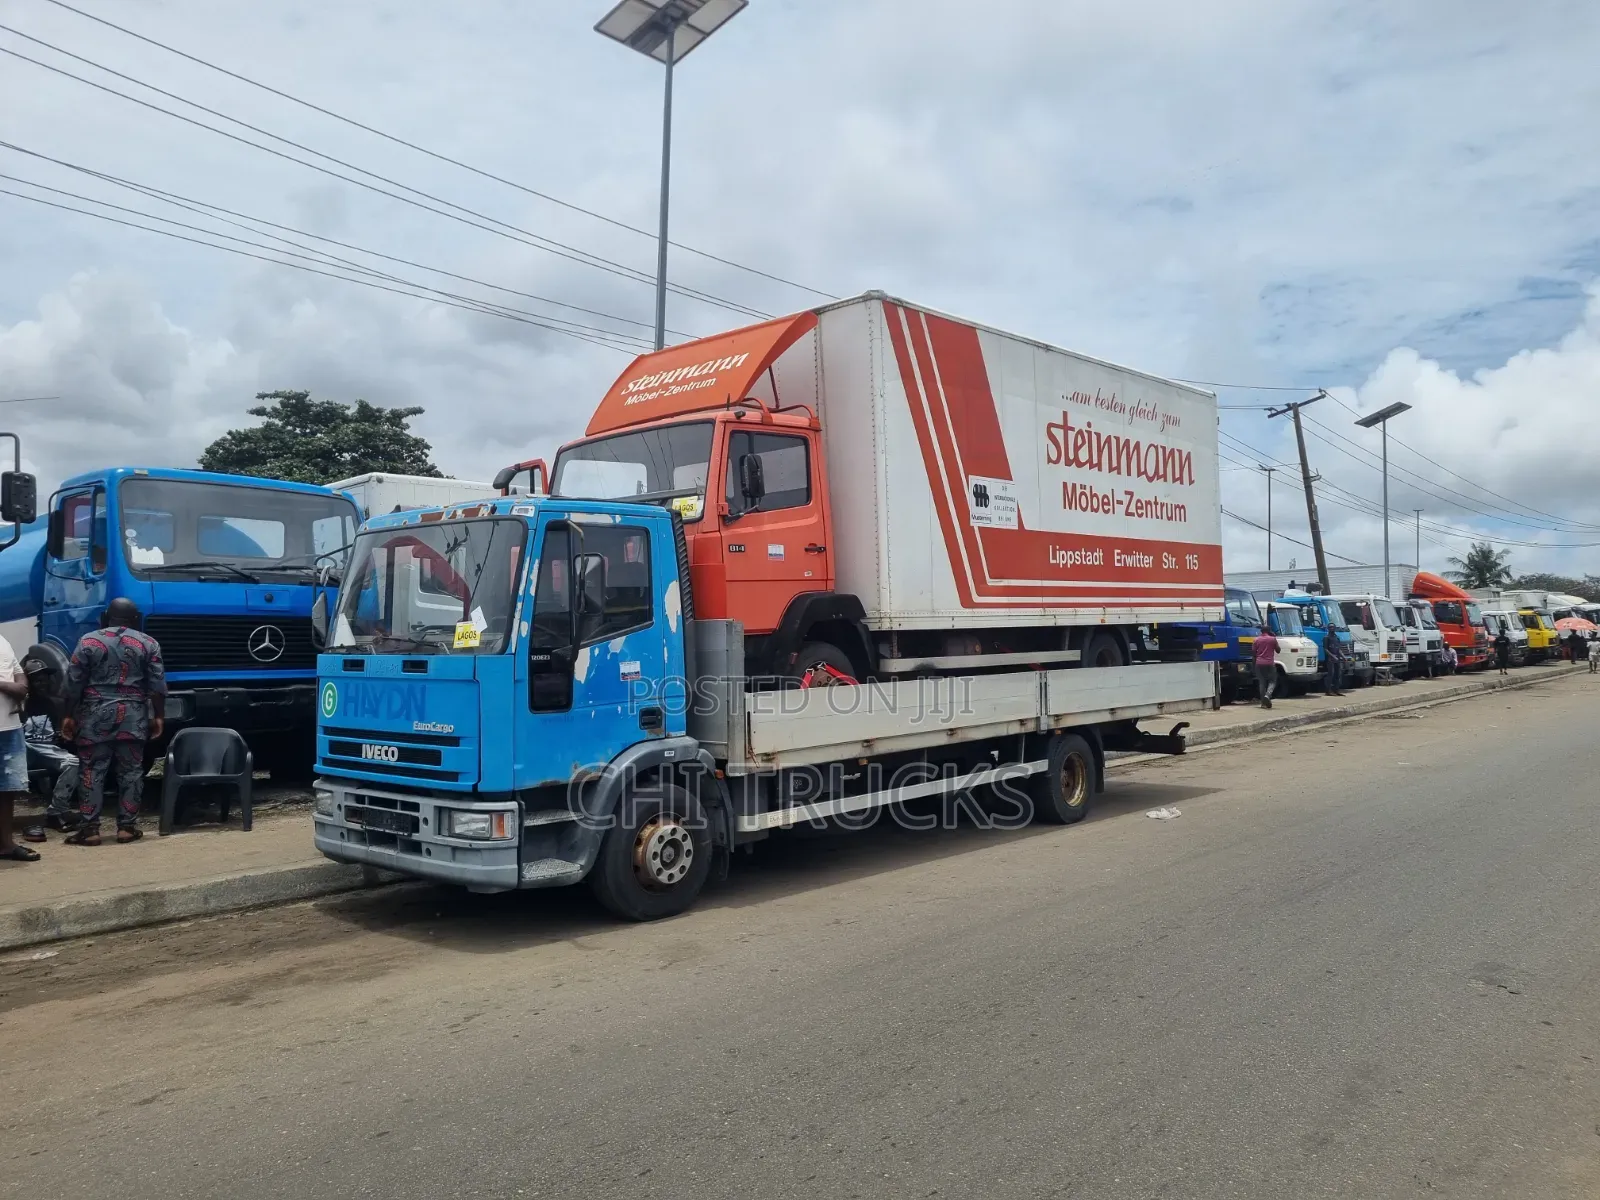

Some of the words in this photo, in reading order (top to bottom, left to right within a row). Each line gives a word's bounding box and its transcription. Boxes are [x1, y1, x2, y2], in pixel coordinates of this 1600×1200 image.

[620, 352, 749, 395] steinmann
[624, 377, 717, 406] Möbel-Zentrum
[1094, 387, 1127, 415] besten
[1128, 399, 1158, 425] gleich
[1160, 412, 1181, 432] zum
[1046, 410, 1195, 486] steinmann
[1062, 481, 1187, 523] Möbel-Zentrum
[1049, 544, 1104, 568] Lippstadt
[1114, 549, 1154, 568] Erwitter
[1162, 552, 1179, 570] Str.
[1185, 553, 1199, 570] 115
[457, 630, 477, 641] LAGOS
[325, 690, 334, 711] G
[342, 682, 427, 722] HAYDN
[413, 720, 454, 734] EuroCargo
[361, 743, 399, 762] IVECO
